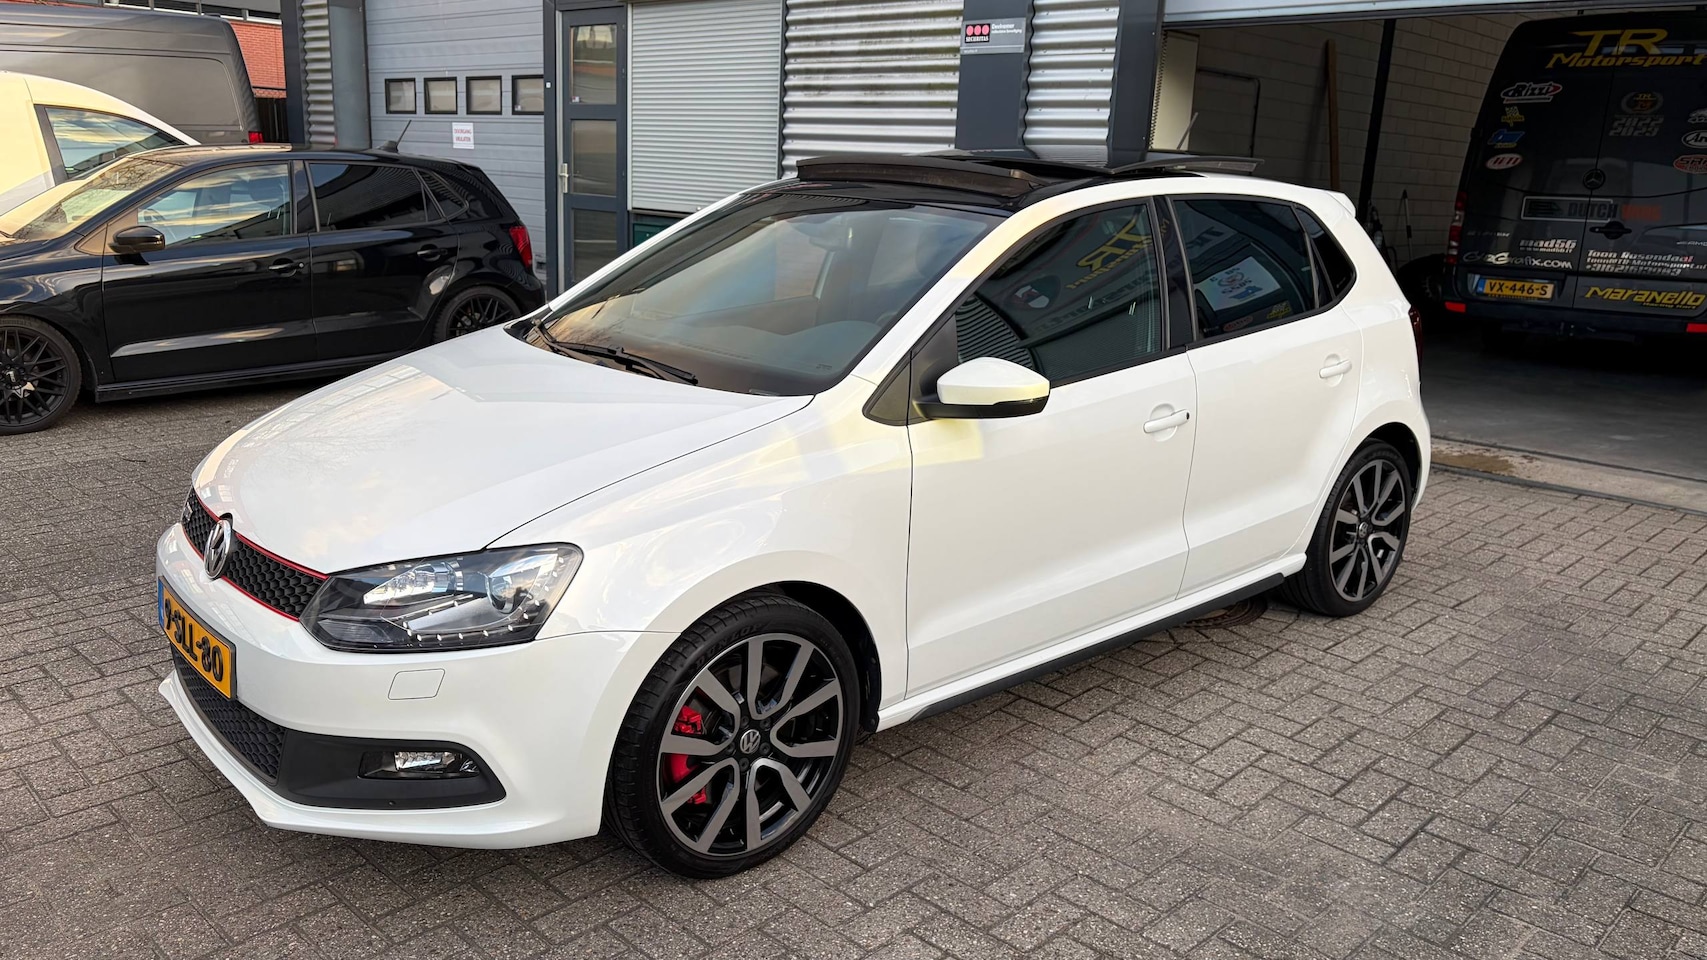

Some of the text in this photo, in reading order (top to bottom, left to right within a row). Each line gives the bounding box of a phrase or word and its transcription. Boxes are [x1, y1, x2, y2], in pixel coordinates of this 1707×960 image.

[1569, 28, 1668, 57] TR
[1545, 52, 1707, 69] Motorsport
[1488, 281, 1548, 296] VX-446-S
[164, 597, 224, 683] 9-SLL-80
